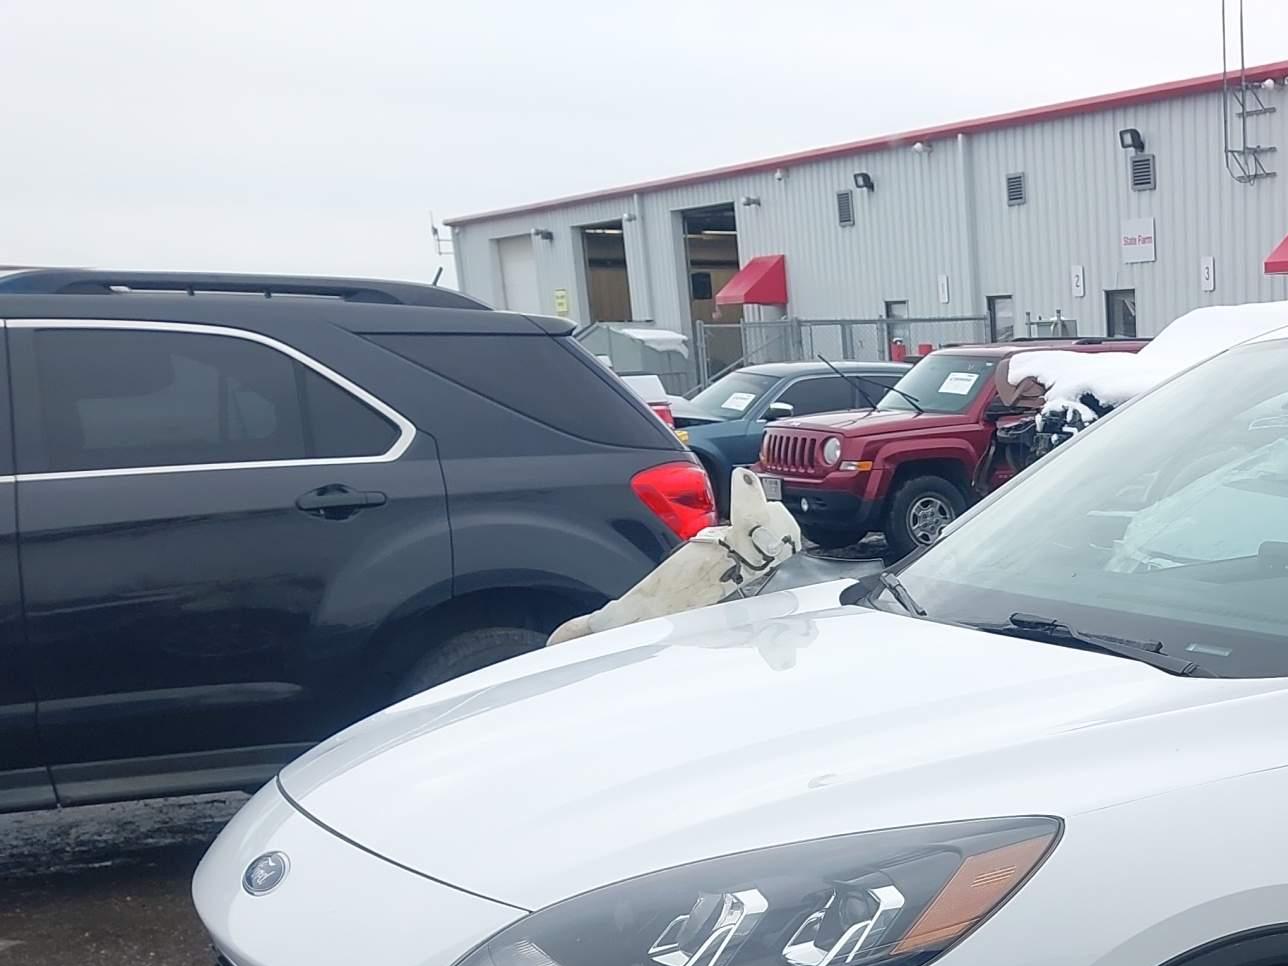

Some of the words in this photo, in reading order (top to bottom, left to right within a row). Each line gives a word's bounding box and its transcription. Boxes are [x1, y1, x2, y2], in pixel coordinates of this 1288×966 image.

[1137, 234, 1153, 245] Farm
[1204, 266, 1210, 281] 3
[1075, 274, 1081, 288] 2
